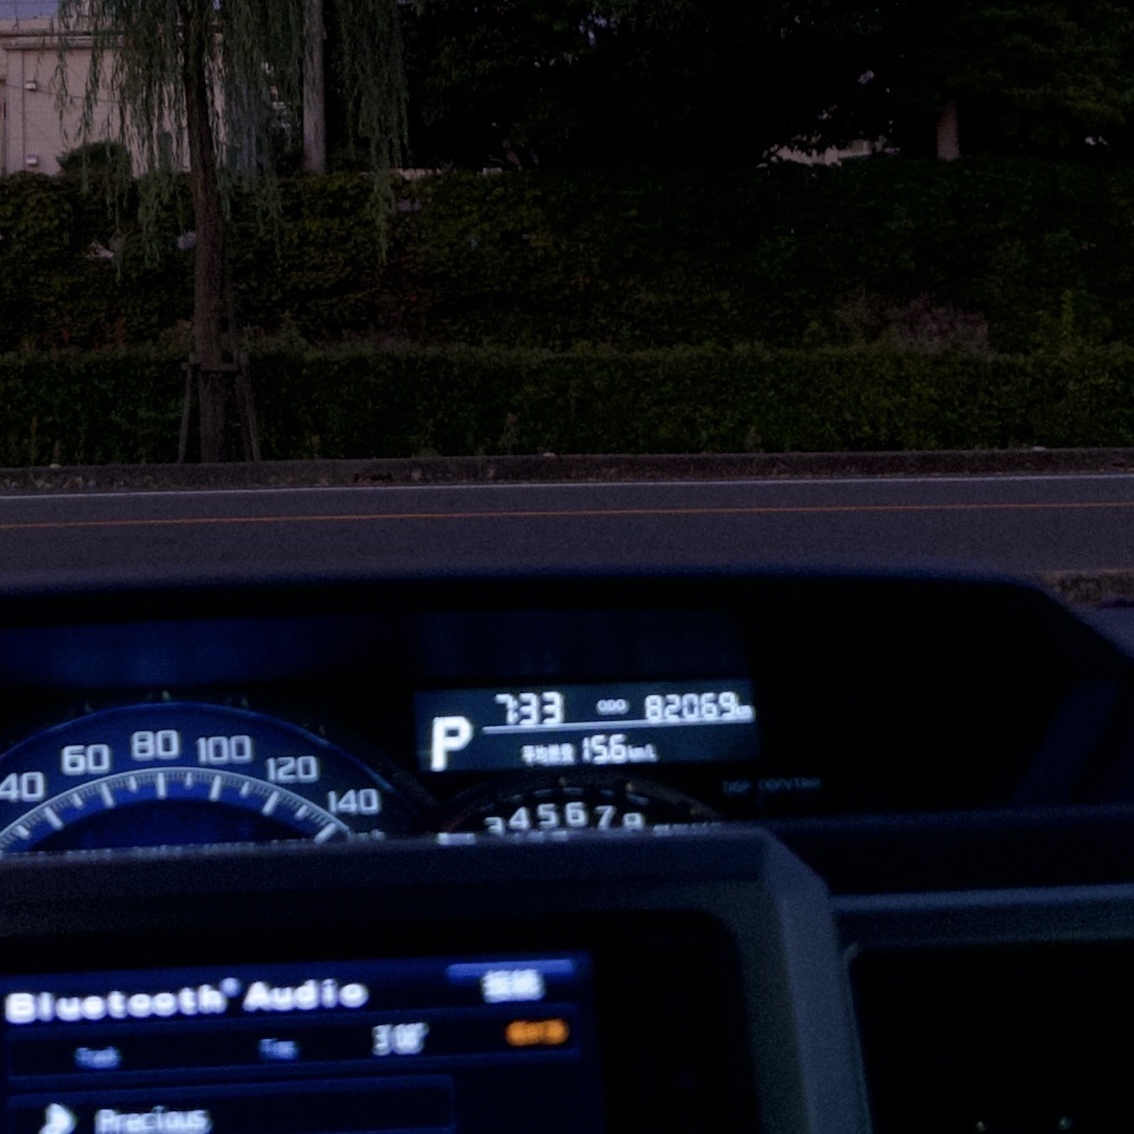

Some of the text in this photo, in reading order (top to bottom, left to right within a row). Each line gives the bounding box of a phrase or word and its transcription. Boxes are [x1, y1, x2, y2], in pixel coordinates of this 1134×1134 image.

[61, 743, 111, 775] 60
[131, 729, 180, 761] 80
[196, 734, 253, 765] 100
[429, 715, 473, 772] P
[266, 755, 319, 784] 120
[328, 787, 381, 816] 140
[508, 806, 530, 831] 4
[537, 803, 558, 829] 5
[565, 801, 588, 828] 6
[595, 804, 616, 831] 7
[242, 978, 368, 1012] Audio
[93, 1105, 213, 1134] Precious
